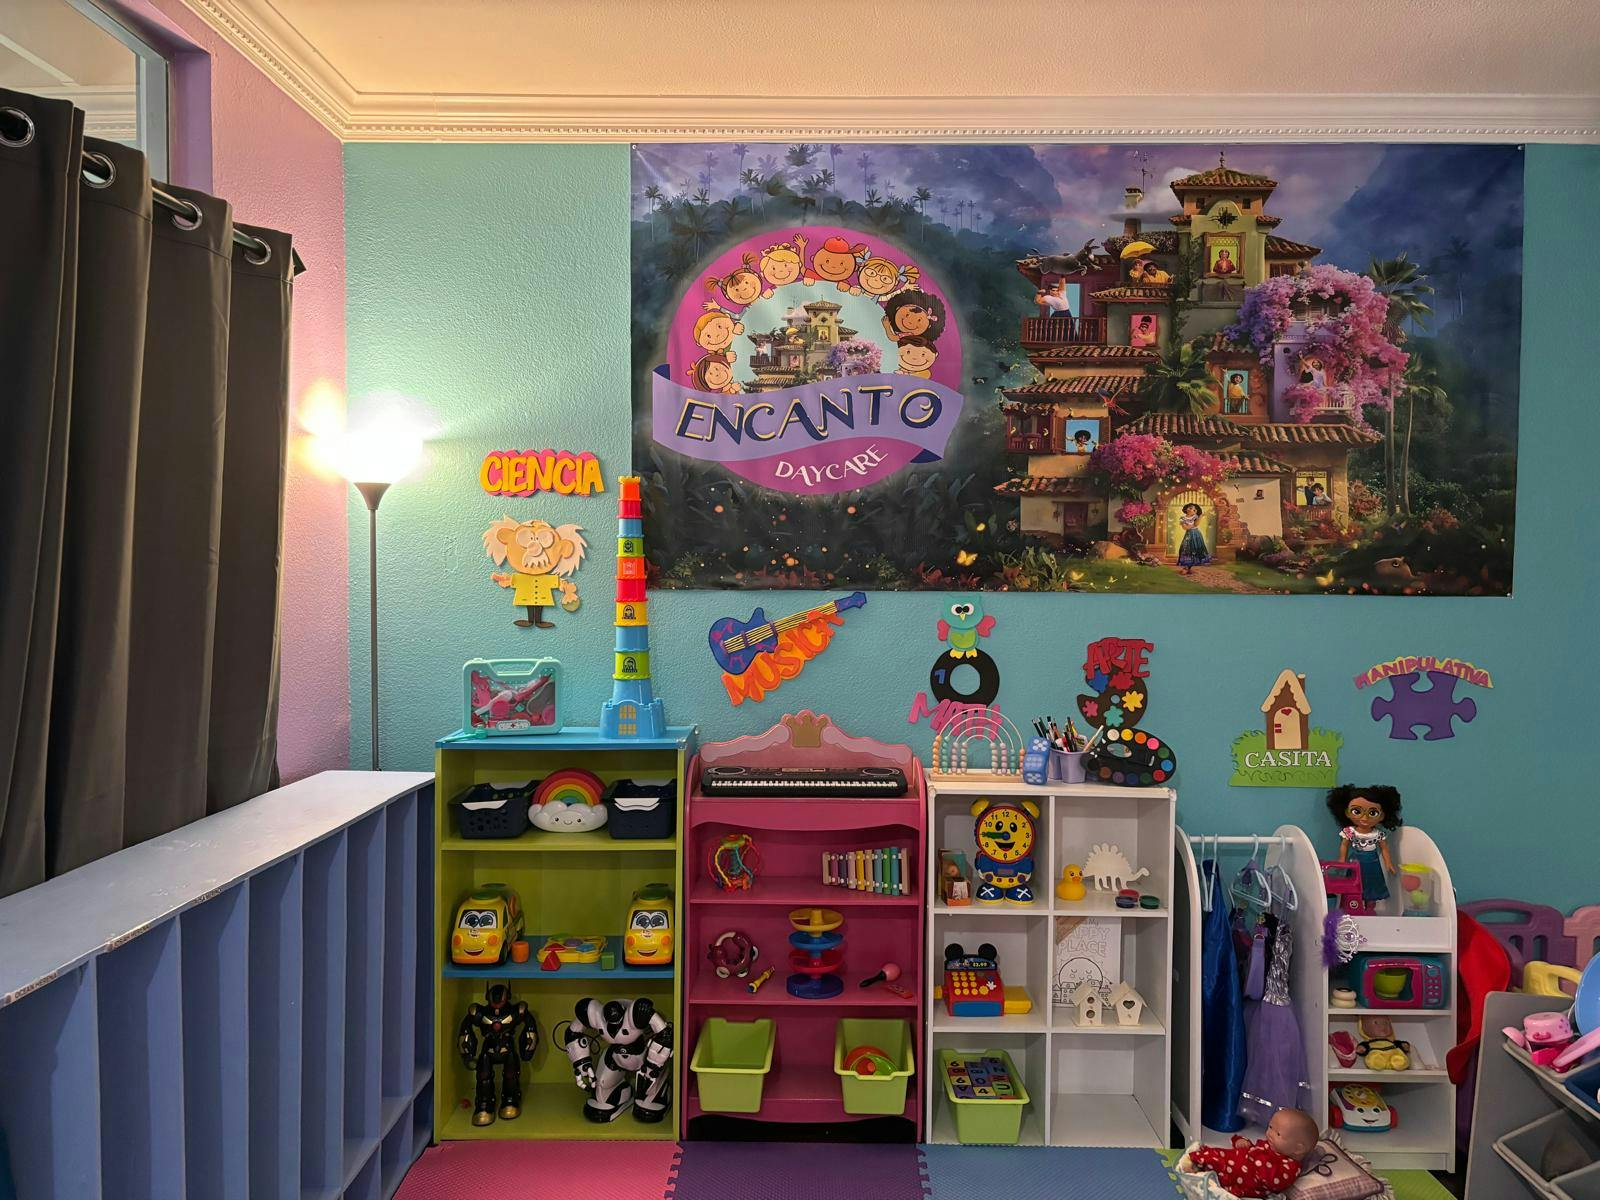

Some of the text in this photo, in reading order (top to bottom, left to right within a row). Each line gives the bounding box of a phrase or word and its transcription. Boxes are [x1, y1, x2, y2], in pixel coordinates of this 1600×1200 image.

[675, 385, 943, 445] ENCANTO
[480, 453, 605, 496] CIENCIA
[775, 443, 889, 487] DAYCARE
[1083, 637, 1154, 680] ARTE
[1354, 655, 1492, 689] MANIPULATIVA
[908, 692, 1003, 742] MATH
[1245, 750, 1333, 768] CASITA
[1057, 939, 1107, 958] PLACE
